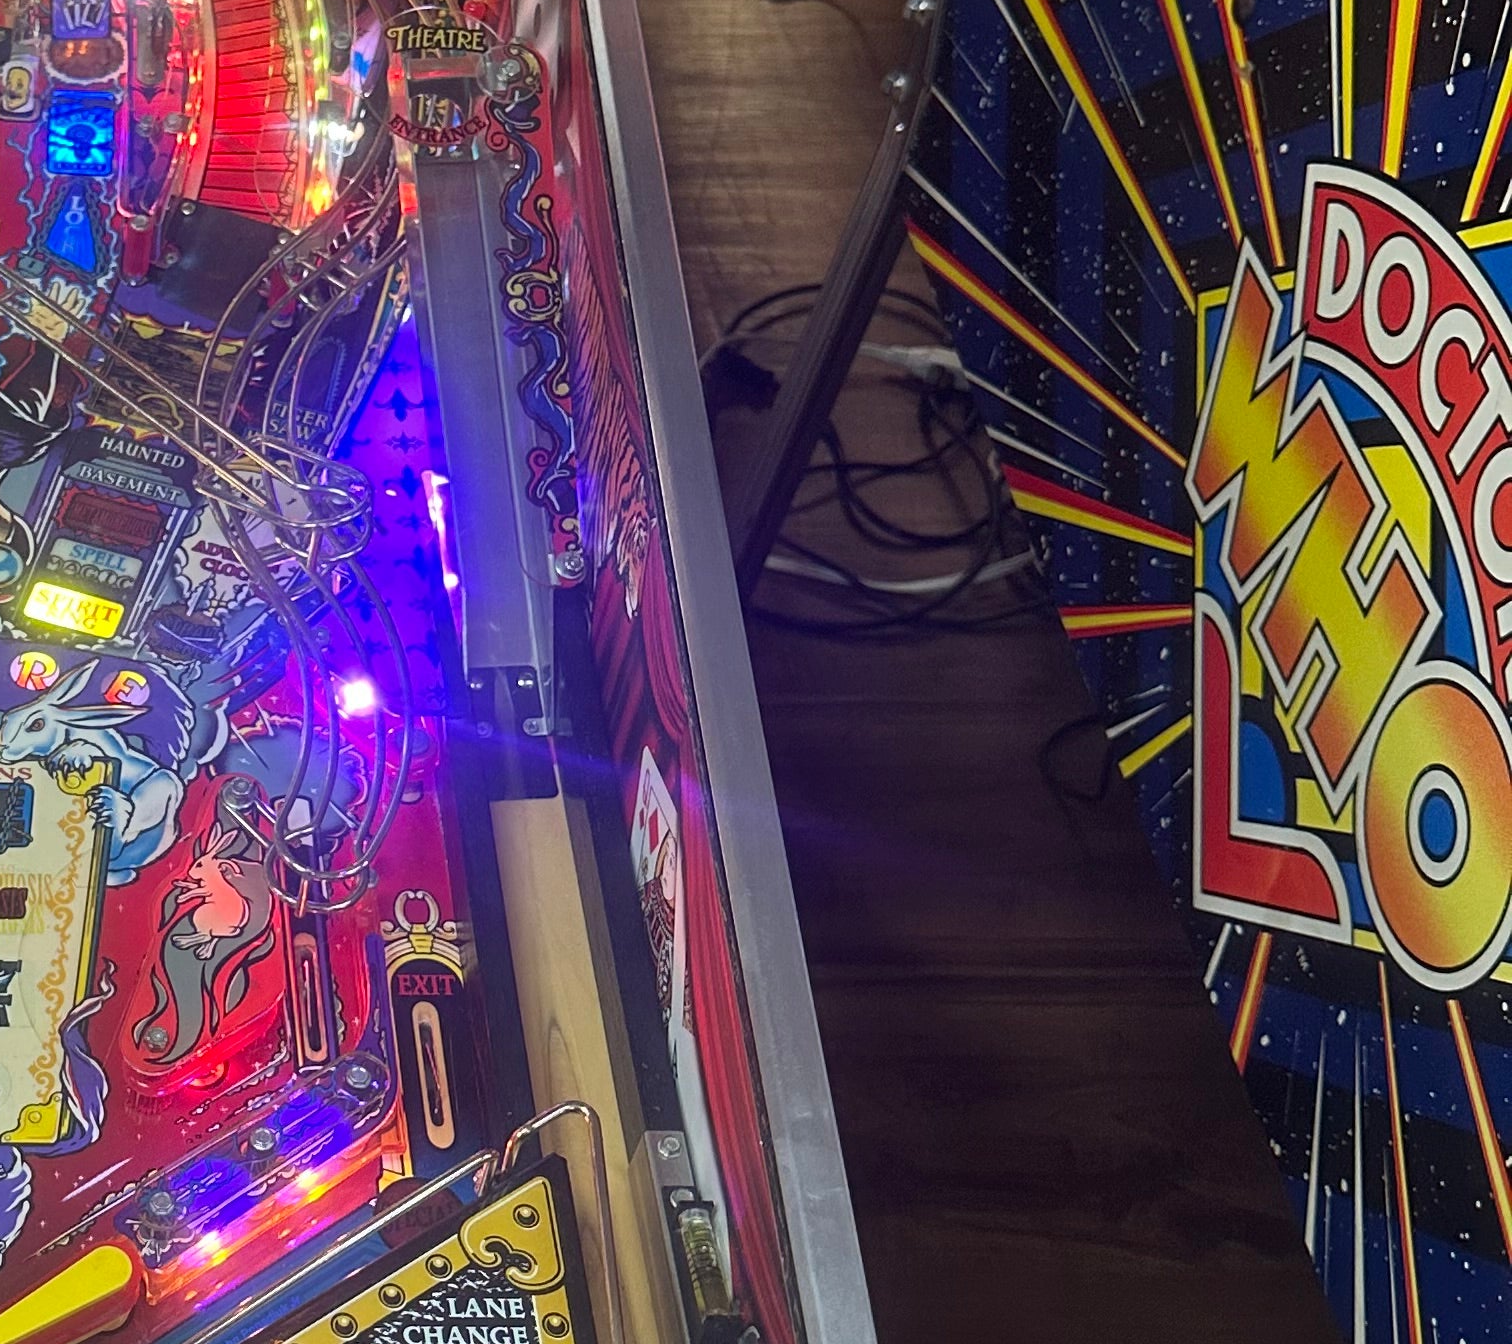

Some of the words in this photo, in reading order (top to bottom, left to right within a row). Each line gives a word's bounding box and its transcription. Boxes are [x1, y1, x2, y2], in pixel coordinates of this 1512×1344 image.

[387, 25, 486, 52] THEATRE
[390, 114, 486, 143] ENTRANCE
[100, 436, 185, 469] HAUNTED
[79, 464, 182, 502] BASEMENT
[70, 543, 126, 572] SPELL
[1187, 237, 1512, 992] WHO
[397, 973, 455, 997] EXIT
[446, 1296, 525, 1320] LANE
